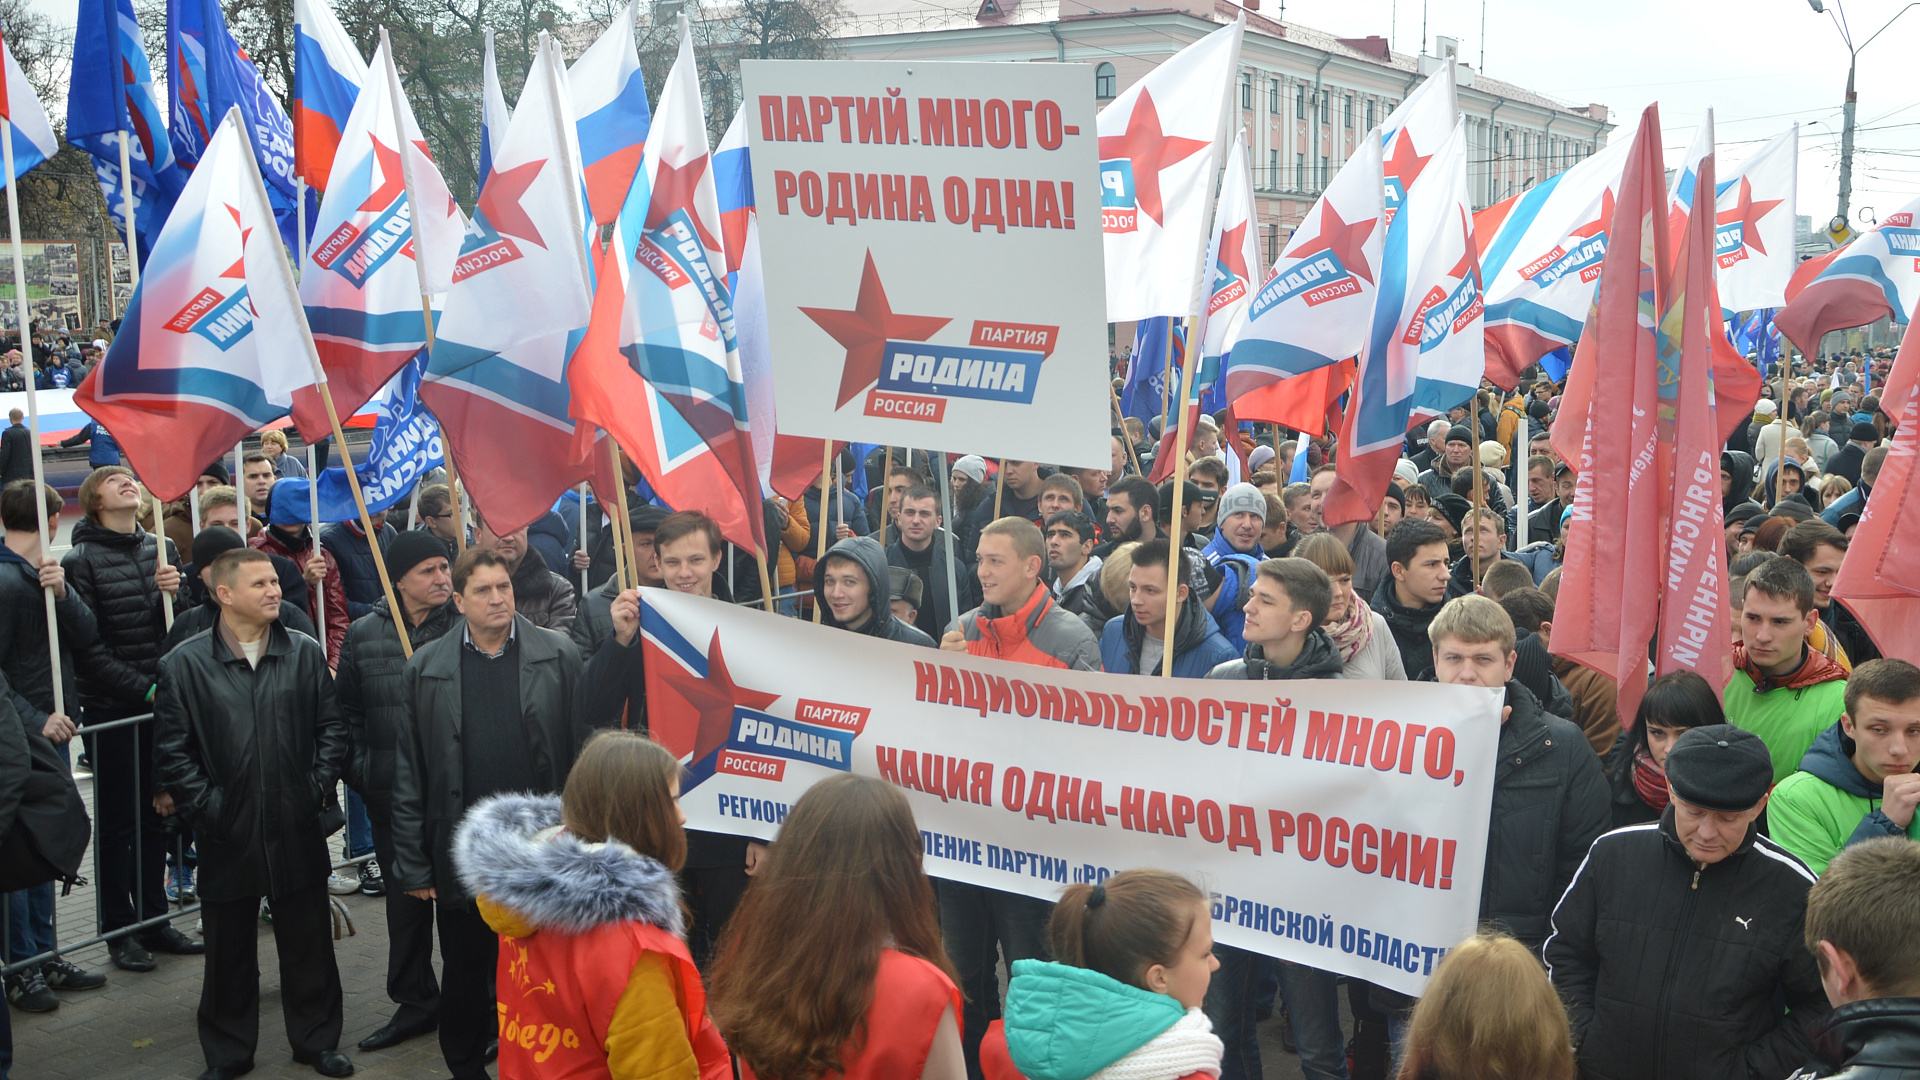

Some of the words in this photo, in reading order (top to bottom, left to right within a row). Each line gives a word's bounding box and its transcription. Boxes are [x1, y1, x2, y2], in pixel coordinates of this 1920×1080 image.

[758, 87, 909, 145] ПАРТИЙ
[918, 97, 1080, 150] МНОГО-
[774, 170, 936, 226] РОДИНА
[943, 176, 1076, 233] ОДНА!
[660, 220, 738, 342] РОДИНА
[980, 326, 1048, 346] ПАРТИЯ
[889, 353, 1026, 392] РОДИНА
[873, 398, 936, 417] РОССИЯ
[737, 718, 844, 763] РОДИНА
[803, 705, 861, 726] ПАРТИЯ
[913, 660, 1297, 757] НАЦИОНАЛЬНОСТЕЙ
[1303, 711, 1465, 787] МНОГО,
[723, 756, 778, 775] РОССИЯ
[875, 745, 994, 807] НАЦИЯ
[1002, 766, 1262, 856] ОДНА-НАРОД
[1268, 810, 1457, 890] РОССИИ!
[718, 793, 794, 825] РЕГИОН
[986, 844, 1068, 884] ПАРТИИ
[1209, 892, 1334, 949] БРЯНСКОЙ
